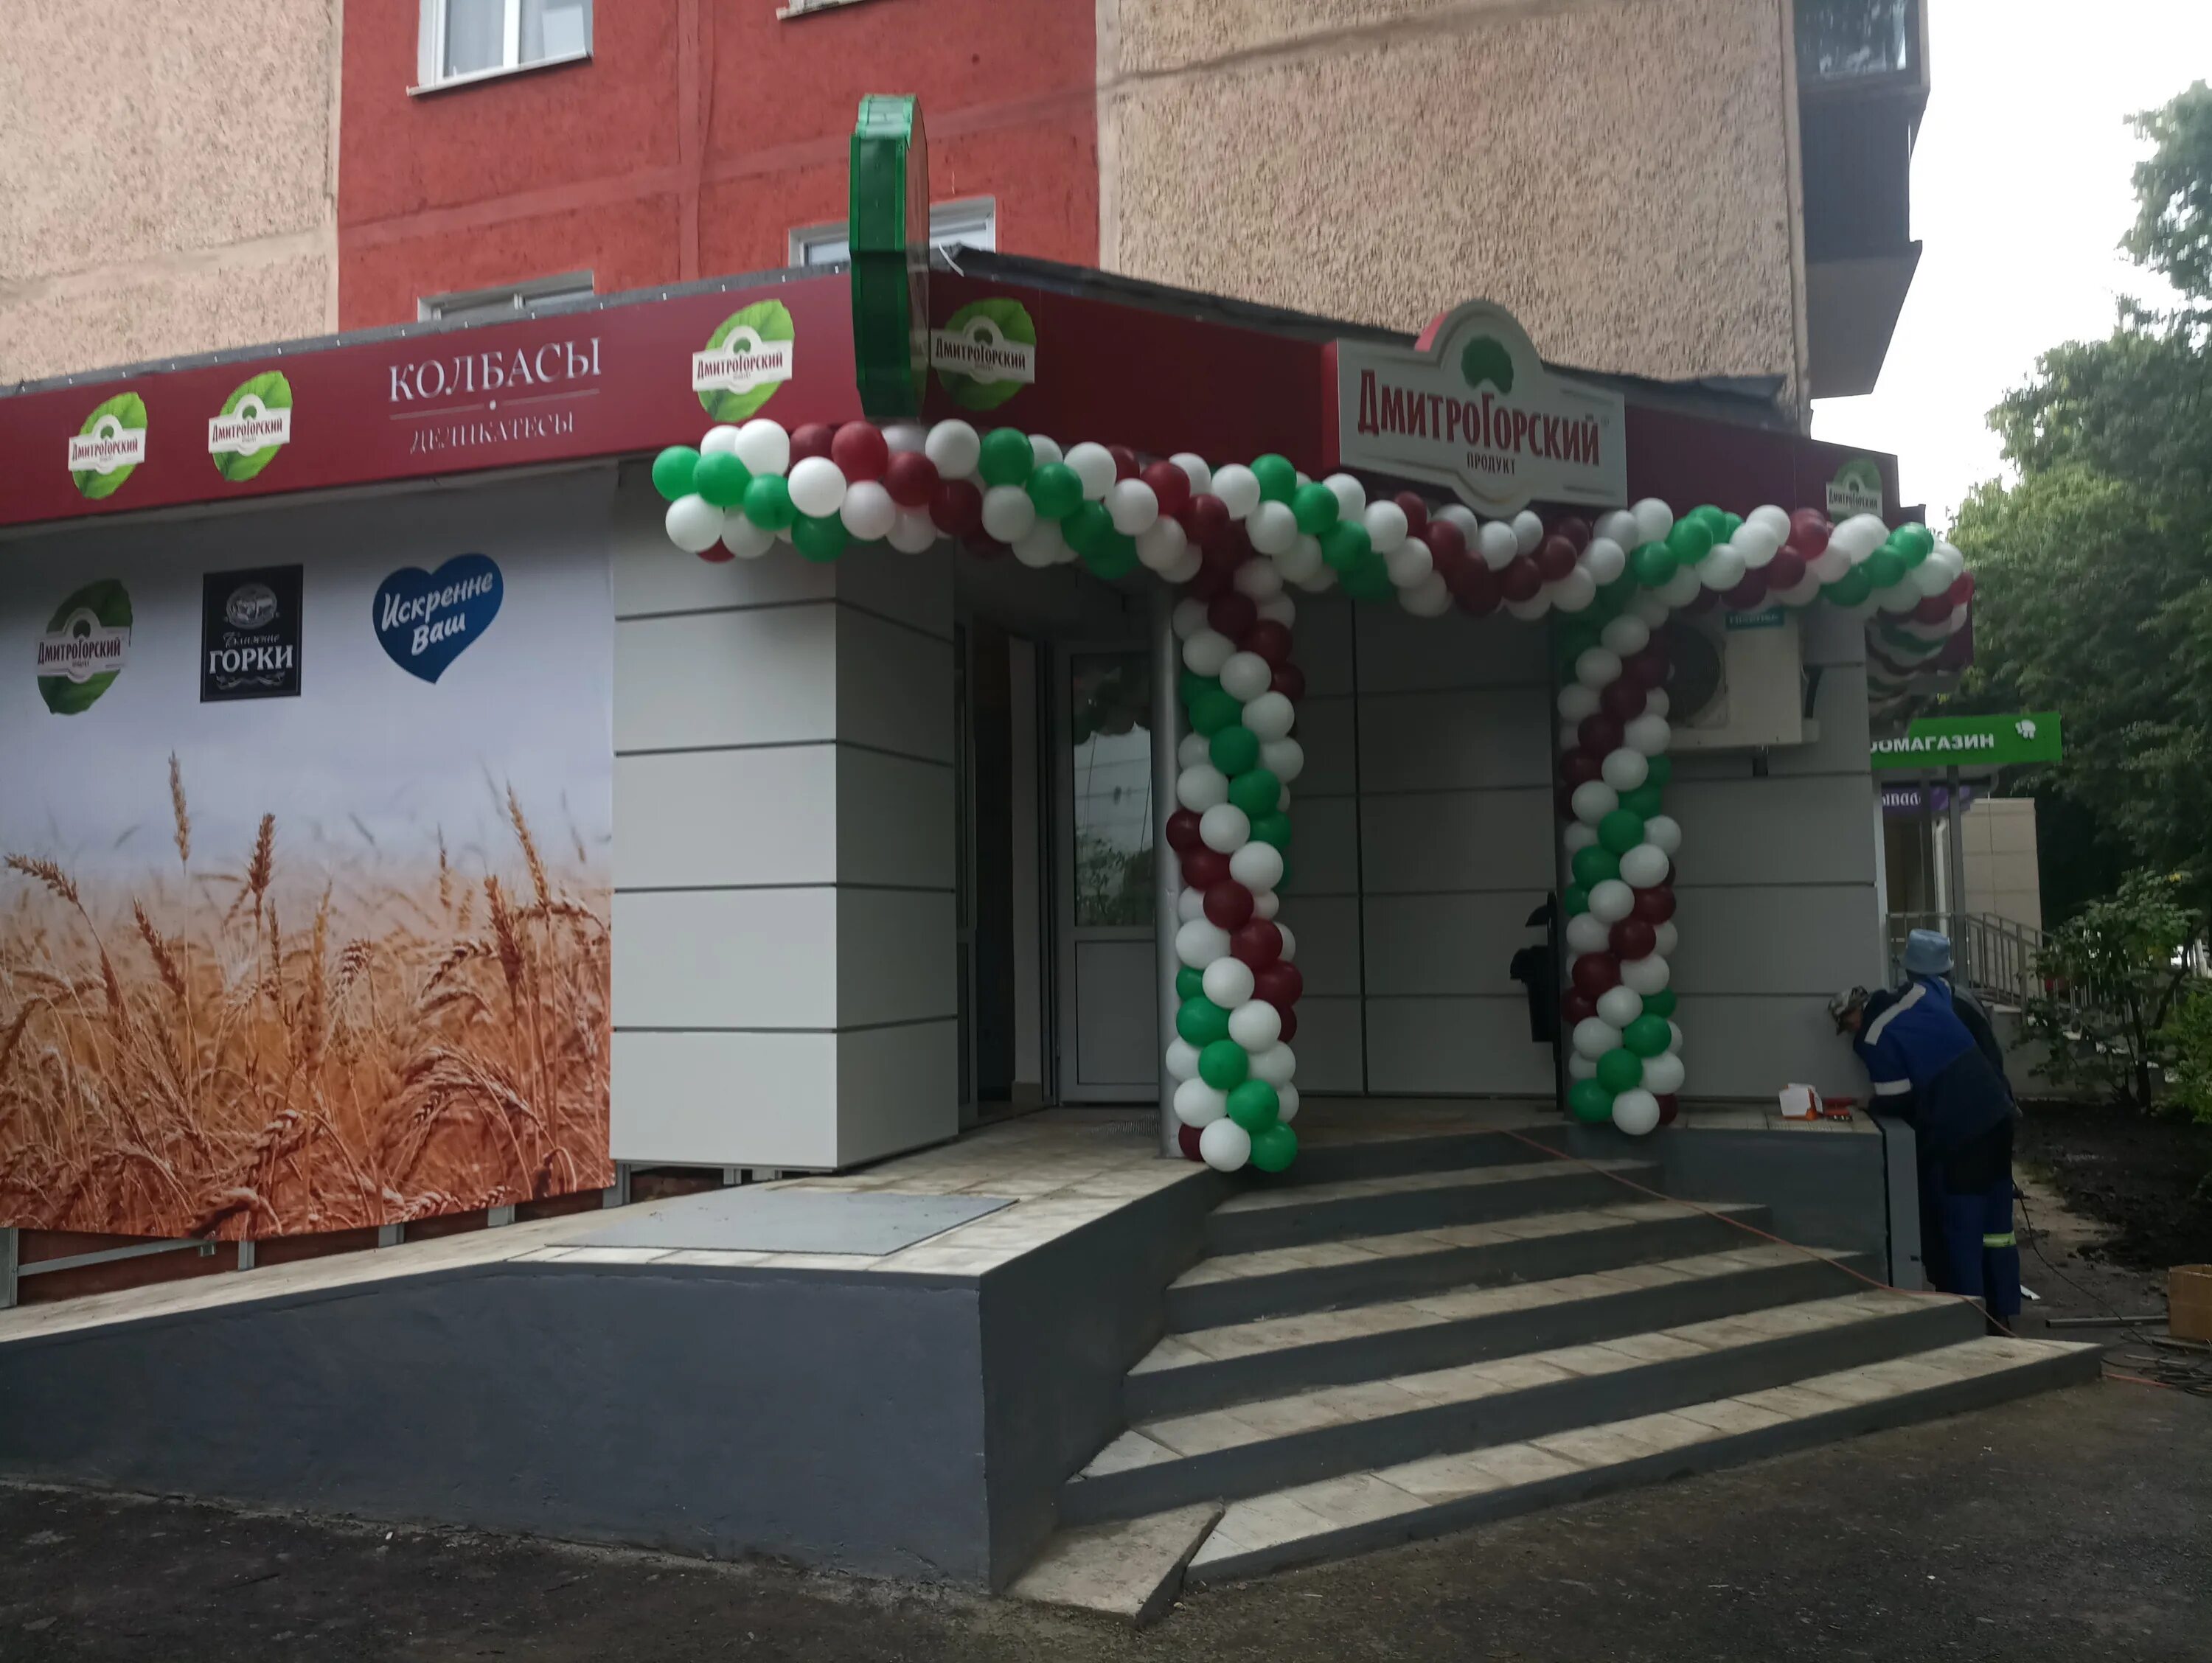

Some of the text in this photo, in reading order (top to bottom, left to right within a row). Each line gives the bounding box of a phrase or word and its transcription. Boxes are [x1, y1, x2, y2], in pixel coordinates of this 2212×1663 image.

[389, 337, 602, 402] КОЛБАСЫ
[1466, 451, 1515, 475] ПРОДУКТ
[381, 572, 493, 632] Искренне
[411, 613, 466, 656] Ваш
[209, 644, 293, 674] ГОРКИ
